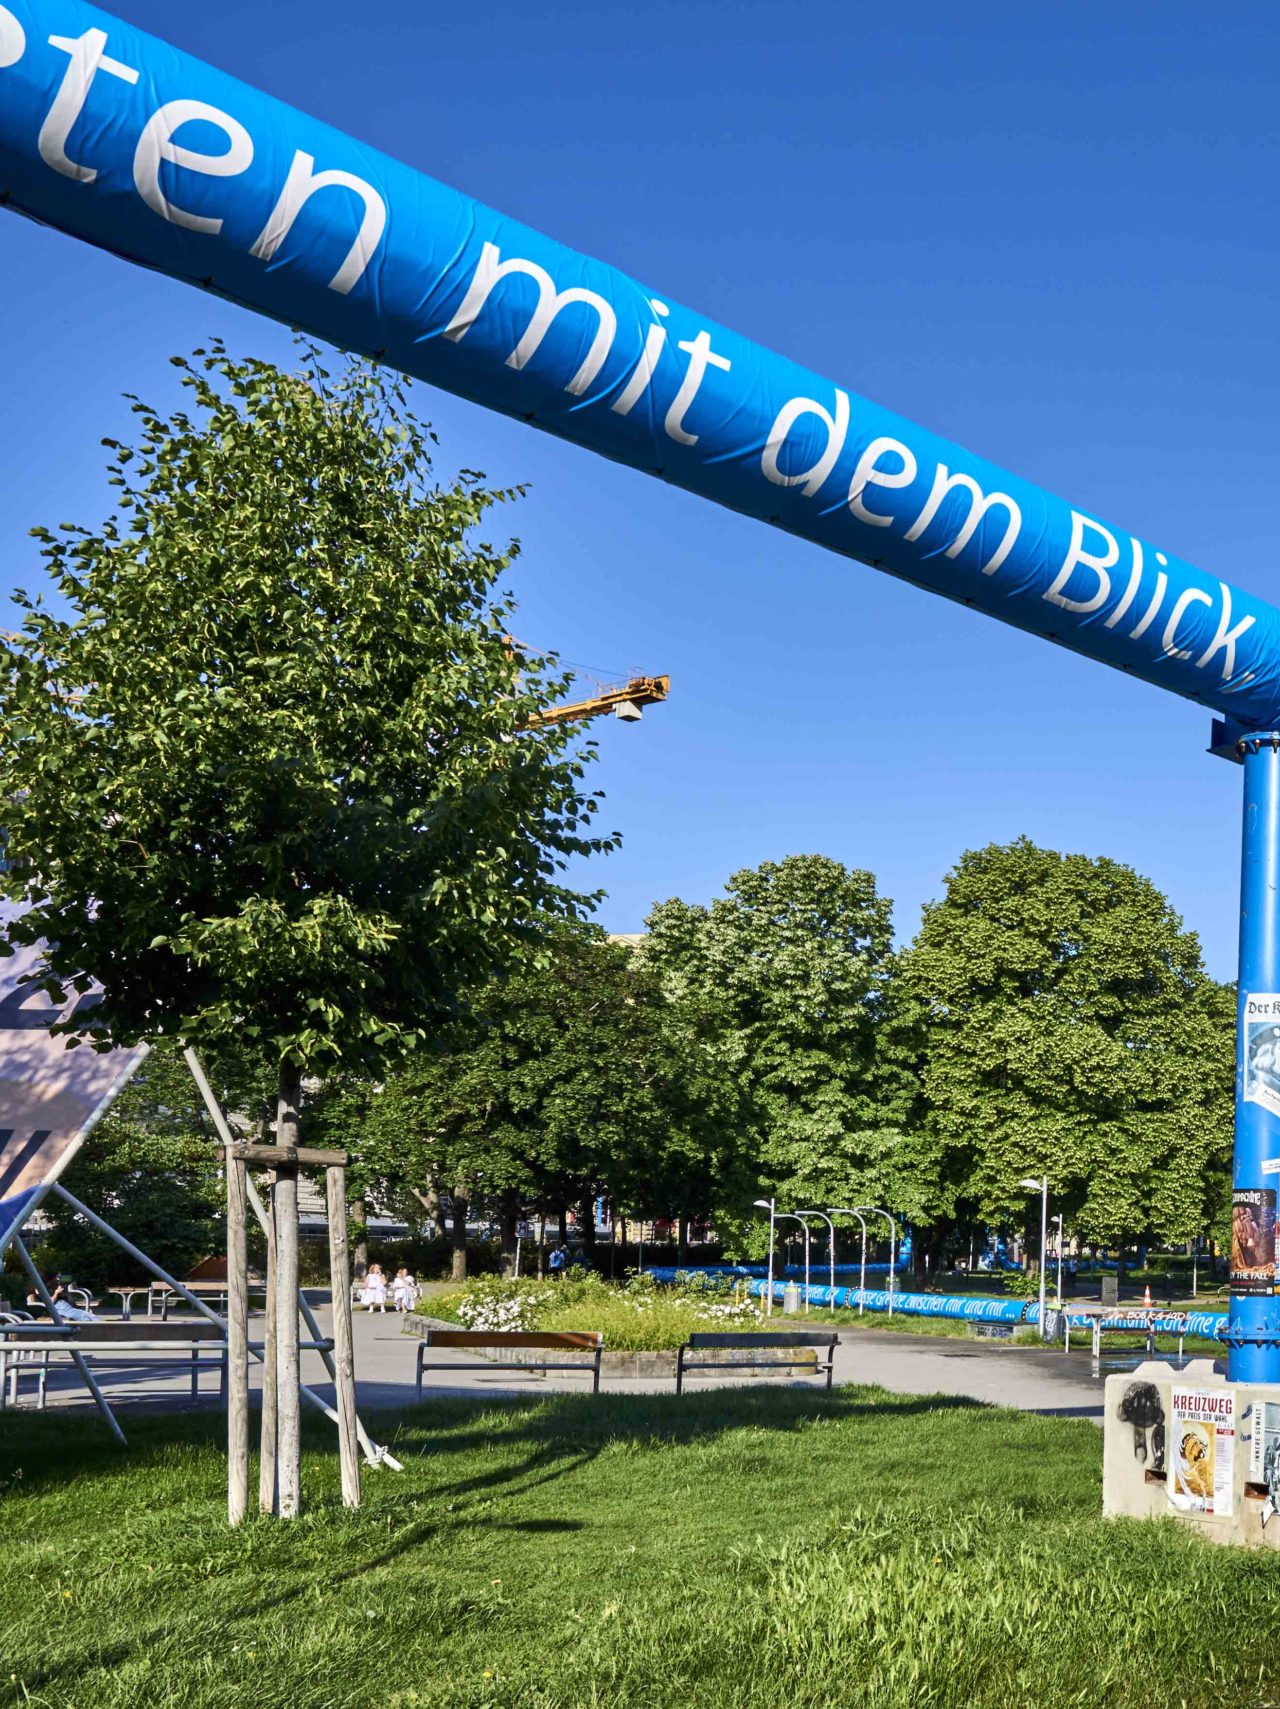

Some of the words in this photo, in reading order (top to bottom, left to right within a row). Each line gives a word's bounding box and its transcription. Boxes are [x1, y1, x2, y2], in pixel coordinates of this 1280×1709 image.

[442, 242, 731, 446] mit
[761, 389, 1022, 576] dem
[1247, 1001, 1270, 1014] Der
[1236, 1272, 1250, 1280] THE
[1250, 1272, 1269, 1281] FALL
[904, 1294, 948, 1311] zwischen
[945, 1297, 967, 1313] mir
[964, 1300, 988, 1316] und
[986, 1299, 1009, 1317] mir
[1173, 1394, 1232, 1415] KREUZWEG
[1188, 1411, 1201, 1420] PREIS
[1203, 1413, 1213, 1421] DER
